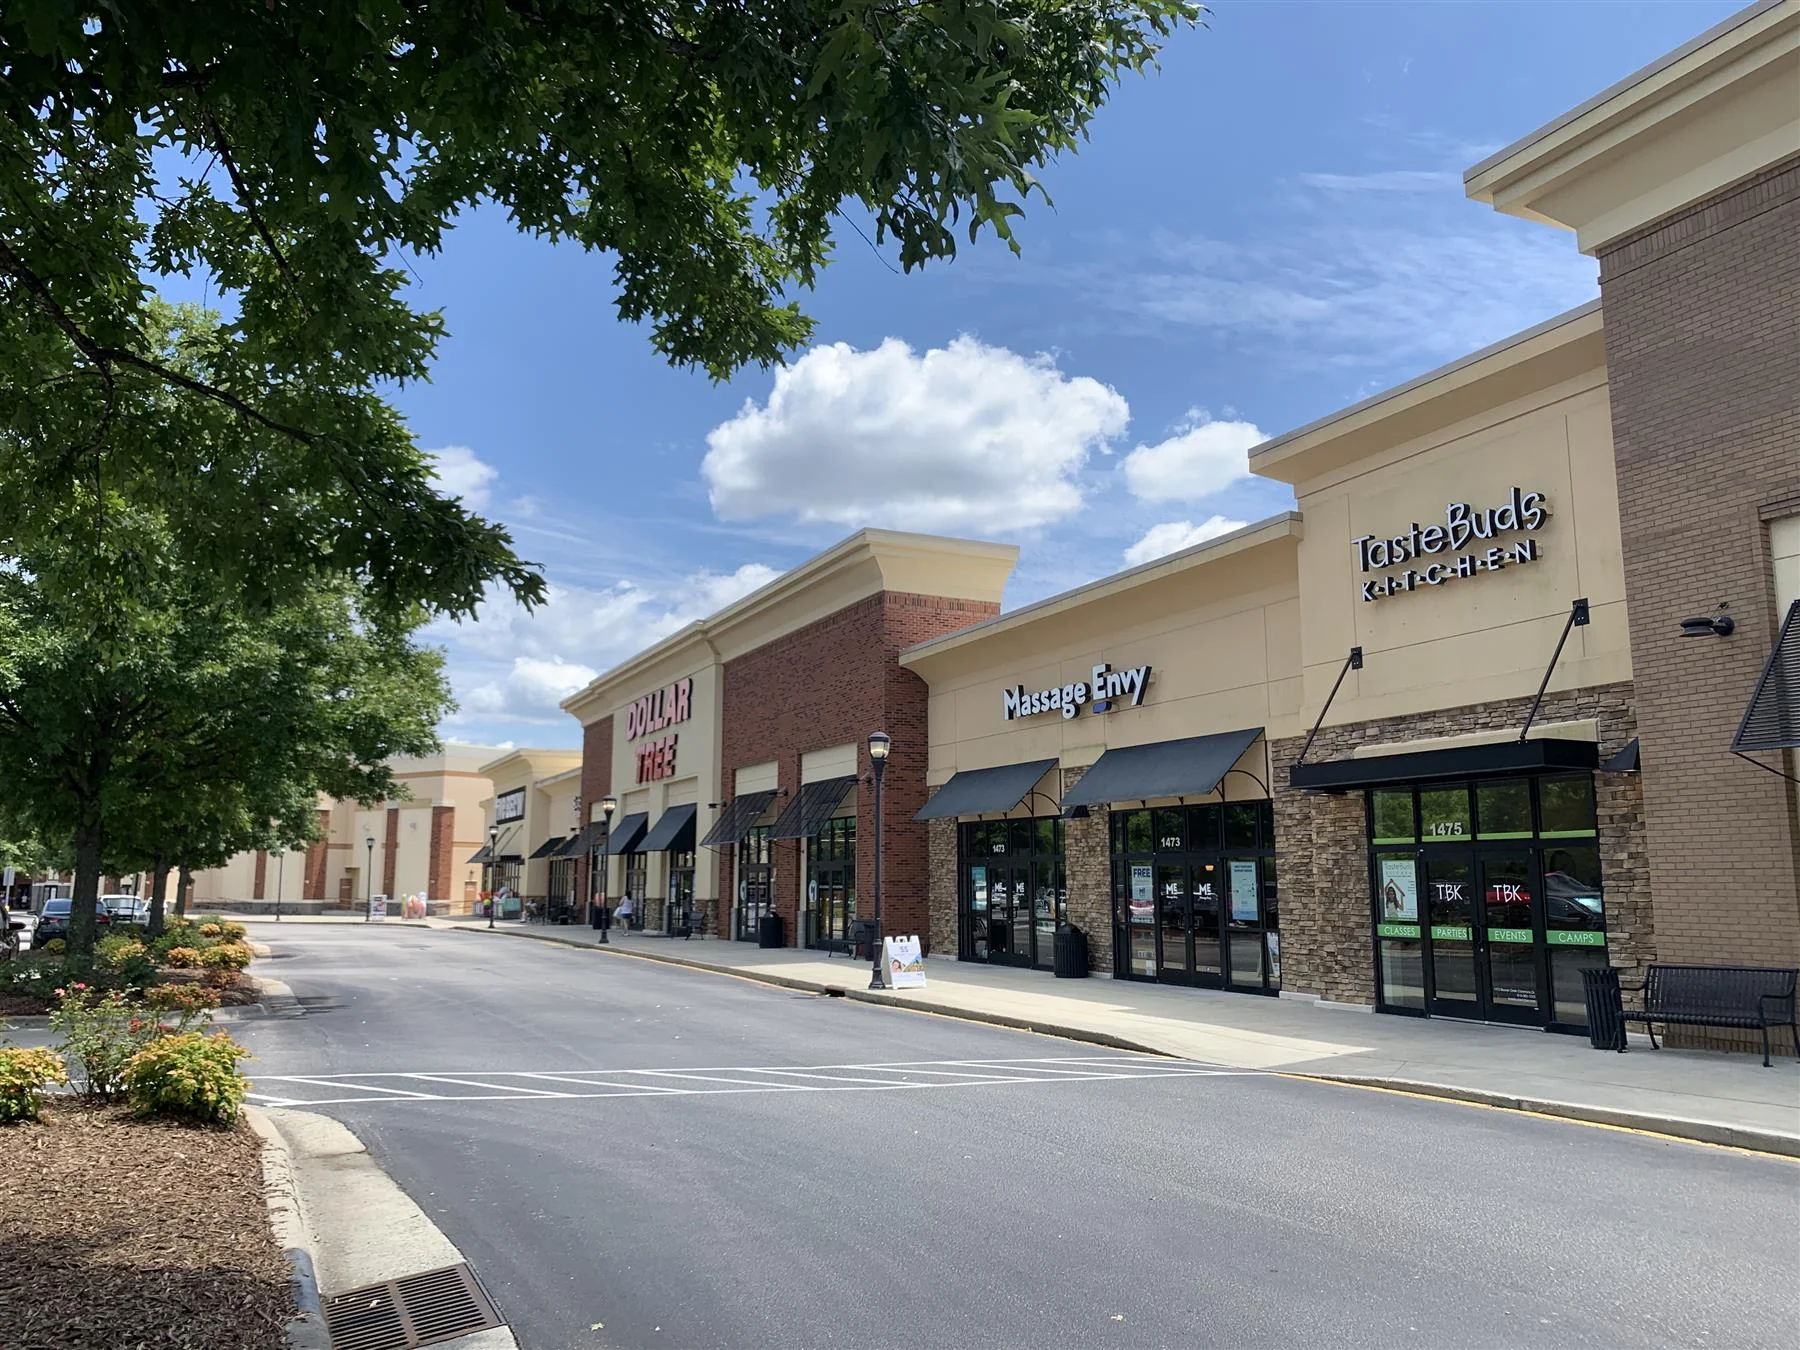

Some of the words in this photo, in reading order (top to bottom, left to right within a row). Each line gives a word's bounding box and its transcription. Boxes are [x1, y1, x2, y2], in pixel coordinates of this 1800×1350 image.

[1351, 486, 1546, 572] TasteBuds
[1003, 684, 1091, 720] Massage
[1092, 663, 1152, 706] Envy
[626, 677, 693, 742] DOLLAR
[634, 734, 679, 784] TREE
[1429, 822, 1463, 836] 1475
[992, 844, 1005, 853] 1473
[1160, 837, 1181, 848] 1473
[1133, 868, 1151, 878] FREE
[1166, 883, 1178, 895] ME
[1198, 883, 1211, 895] ME
[1436, 884, 1463, 901] TBK
[1493, 884, 1522, 902] TBK
[1384, 925, 1416, 937] CLASSES
[1437, 928, 1467, 938] PARTIES
[1494, 930, 1527, 941] EVENTS
[1558, 932, 1594, 944] CAMPS
